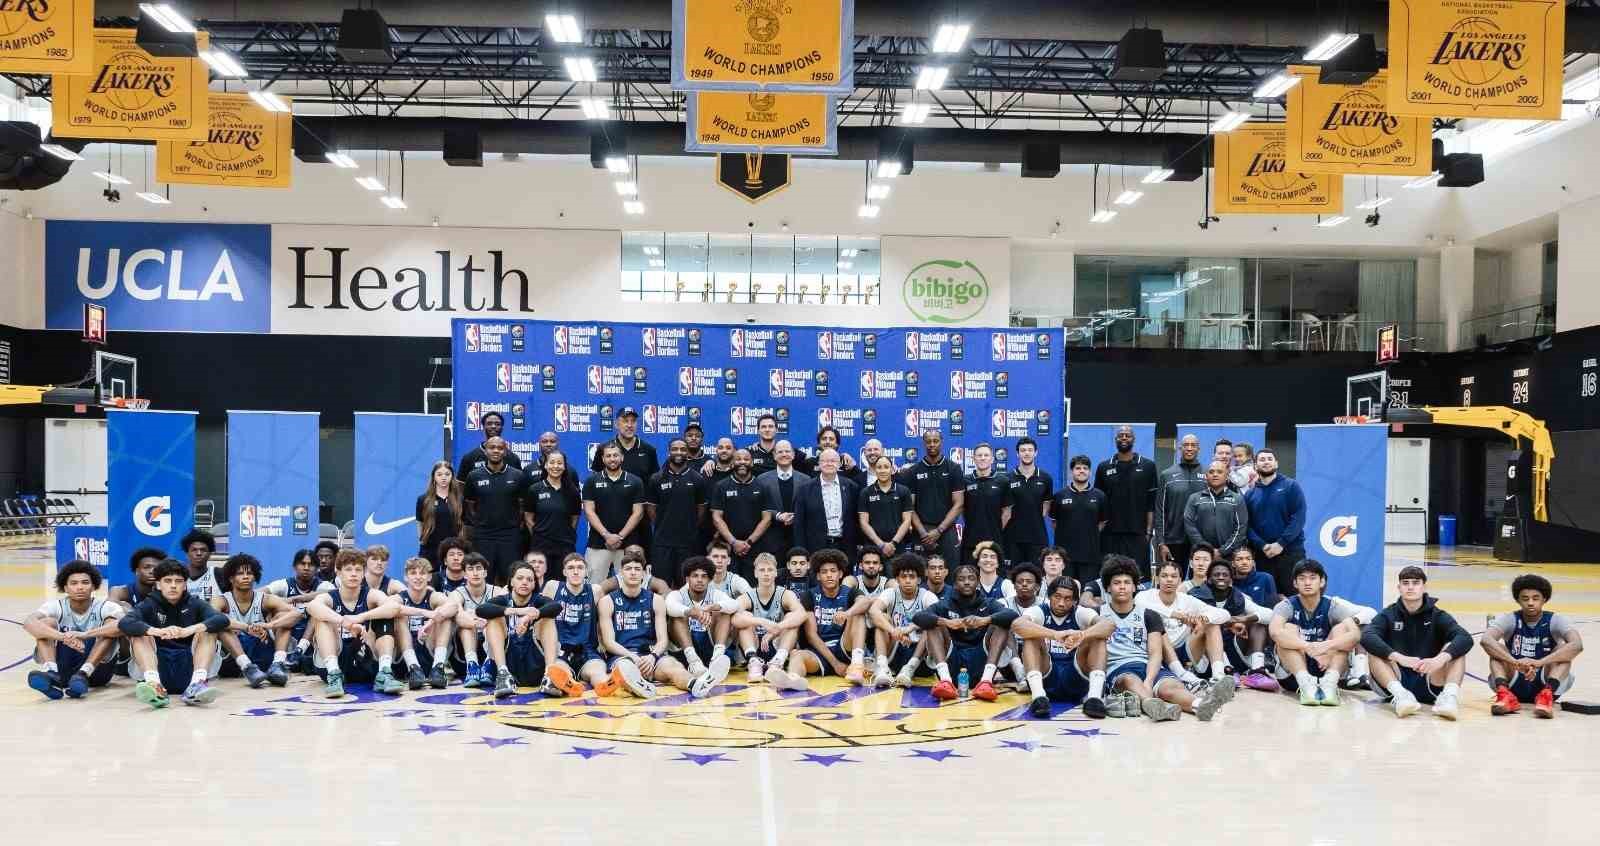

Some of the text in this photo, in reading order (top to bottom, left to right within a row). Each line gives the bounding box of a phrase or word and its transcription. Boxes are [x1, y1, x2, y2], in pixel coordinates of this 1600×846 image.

[46, 48, 68, 57] 1982
[703, 46, 746, 73] WORLD
[750, 50, 822, 76] CHAMPIONS
[1427, 32, 1527, 70] LAKERS
[88, 65, 175, 98] LAKERS
[690, 69, 713, 78] 1949
[811, 72, 834, 81] 1950
[1424, 71, 1528, 98] WORLD CHAMPIONS
[1411, 92, 1432, 100] 2001
[1517, 96, 1538, 104] 2002
[84, 99, 177, 122] WORLD CHAMPIONS
[1320, 102, 1402, 135] LAKERS
[712, 115, 748, 138] WORLD
[750, 118, 810, 139] CHAMPIONS
[1316, 135, 1404, 158] WORLD CHAMPIONS
[184, 150, 265, 172] WORLD CHAMPIONS
[1240, 182, 1318, 201] WORLD CHAMPIONS
[76, 248, 244, 302] UCLA
[288, 247, 535, 312] Health
[912, 277, 982, 304] bibigo
[655, 328, 685, 338] Basketball
[1512, 381, 1528, 404] 24
[1582, 372, 1597, 396] 16
[511, 442, 539, 452] Basketball
[1508, 466, 1516, 478] G
[133, 496, 172, 537] G
[1320, 516, 1358, 556] G
